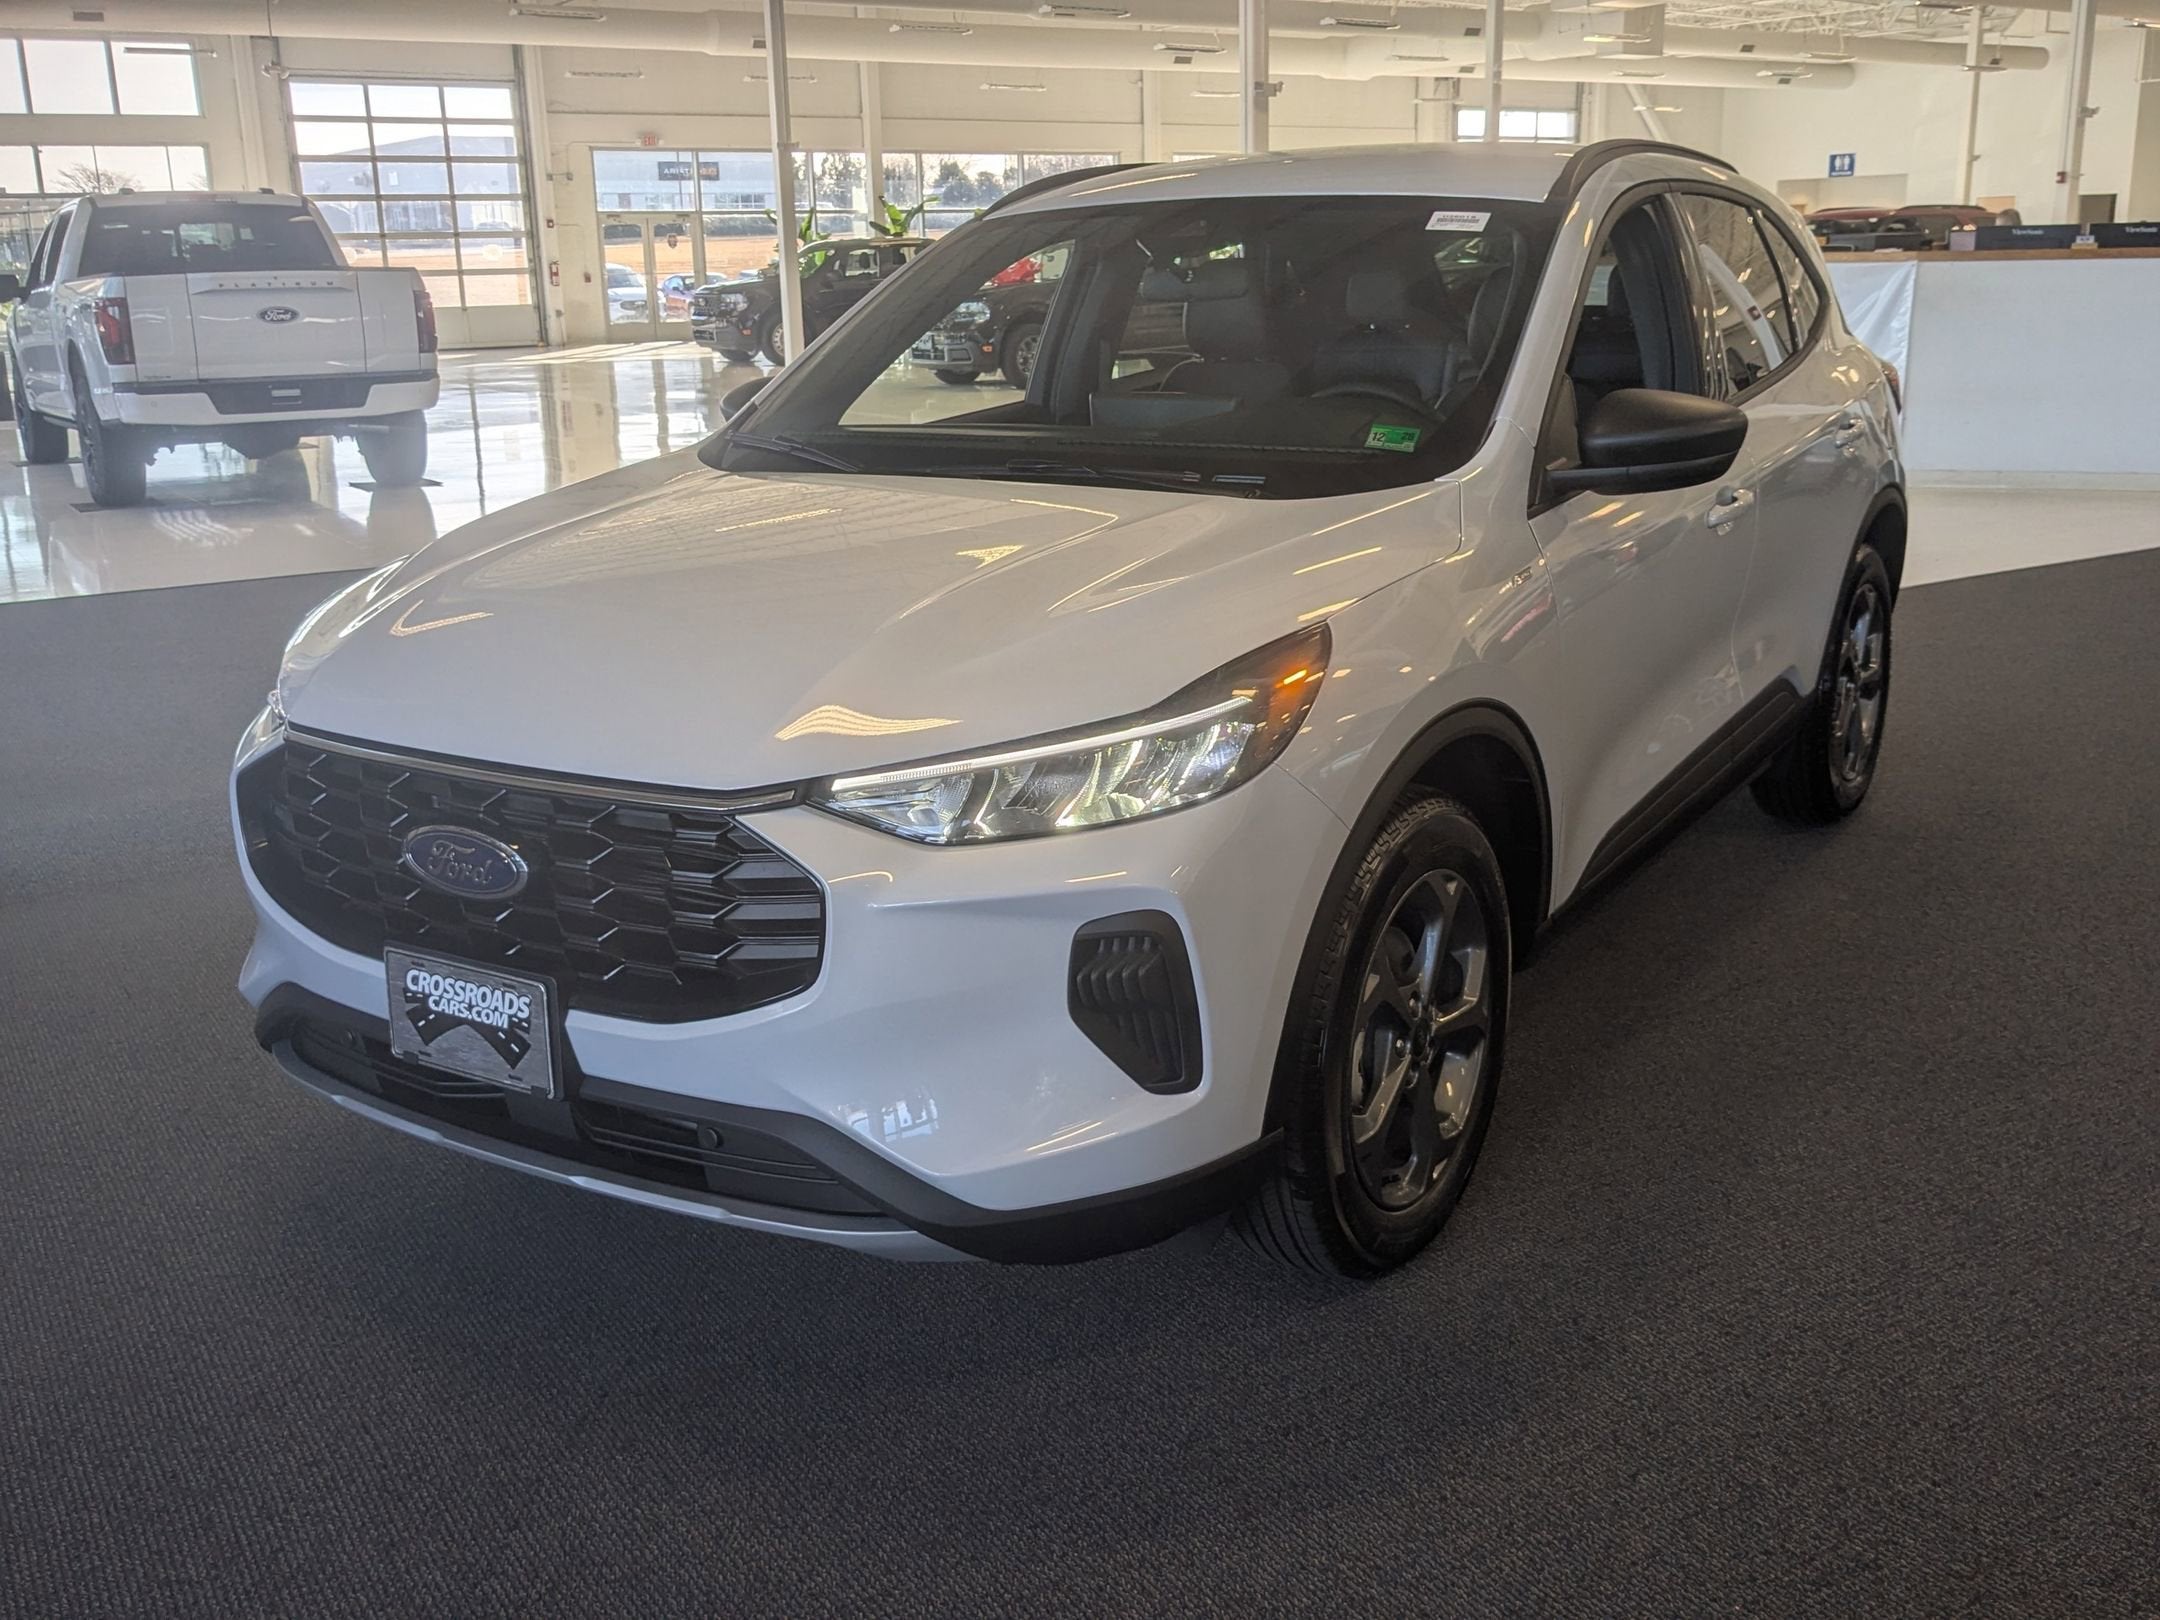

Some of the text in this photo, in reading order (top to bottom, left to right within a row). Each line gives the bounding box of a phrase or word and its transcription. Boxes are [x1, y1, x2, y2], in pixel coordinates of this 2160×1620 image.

[264, 309, 292, 321] Ford
[1372, 432, 1385, 442] 12
[427, 840, 494, 885] Ford
[405, 968, 531, 1019] CROSSROADS
[428, 995, 509, 1029] CARS.COM
